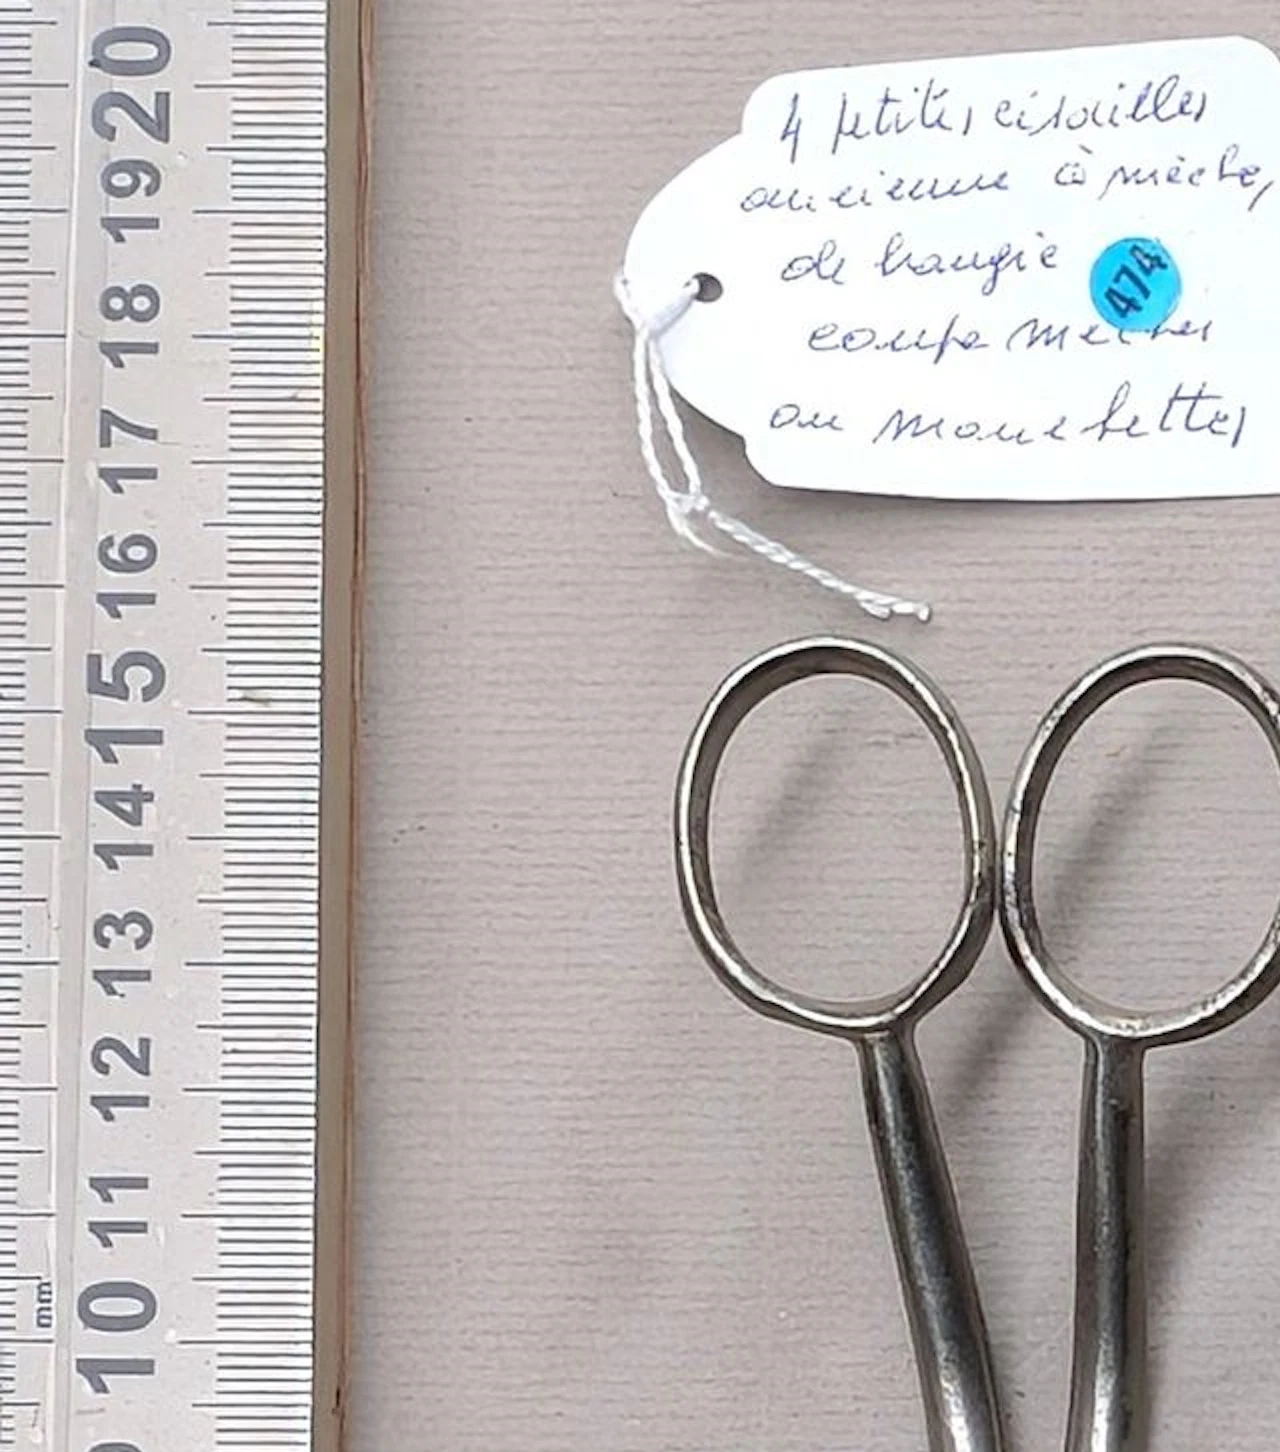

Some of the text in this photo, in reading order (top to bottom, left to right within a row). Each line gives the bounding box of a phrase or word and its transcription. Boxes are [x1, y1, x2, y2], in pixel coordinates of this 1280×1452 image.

[87, 26, 172, 145] 20
[779, 92, 803, 164] 4
[100, 159, 162, 244] 19
[780, 239, 846, 285] de
[1103, 243, 1169, 319] 474
[99, 283, 161, 369] 18
[807, 313, 990, 365] coupe
[97, 408, 160, 495] 17
[96, 533, 158, 620] 16
[84, 650, 167, 765] 15
[93, 783, 156, 871] 14
[93, 910, 154, 999] 13
[91, 1036, 152, 1123] 12
[88, 1176, 150, 1249] 11
[36, 1282, 53, 1328] mm
[75, 1281, 159, 1395] 10
